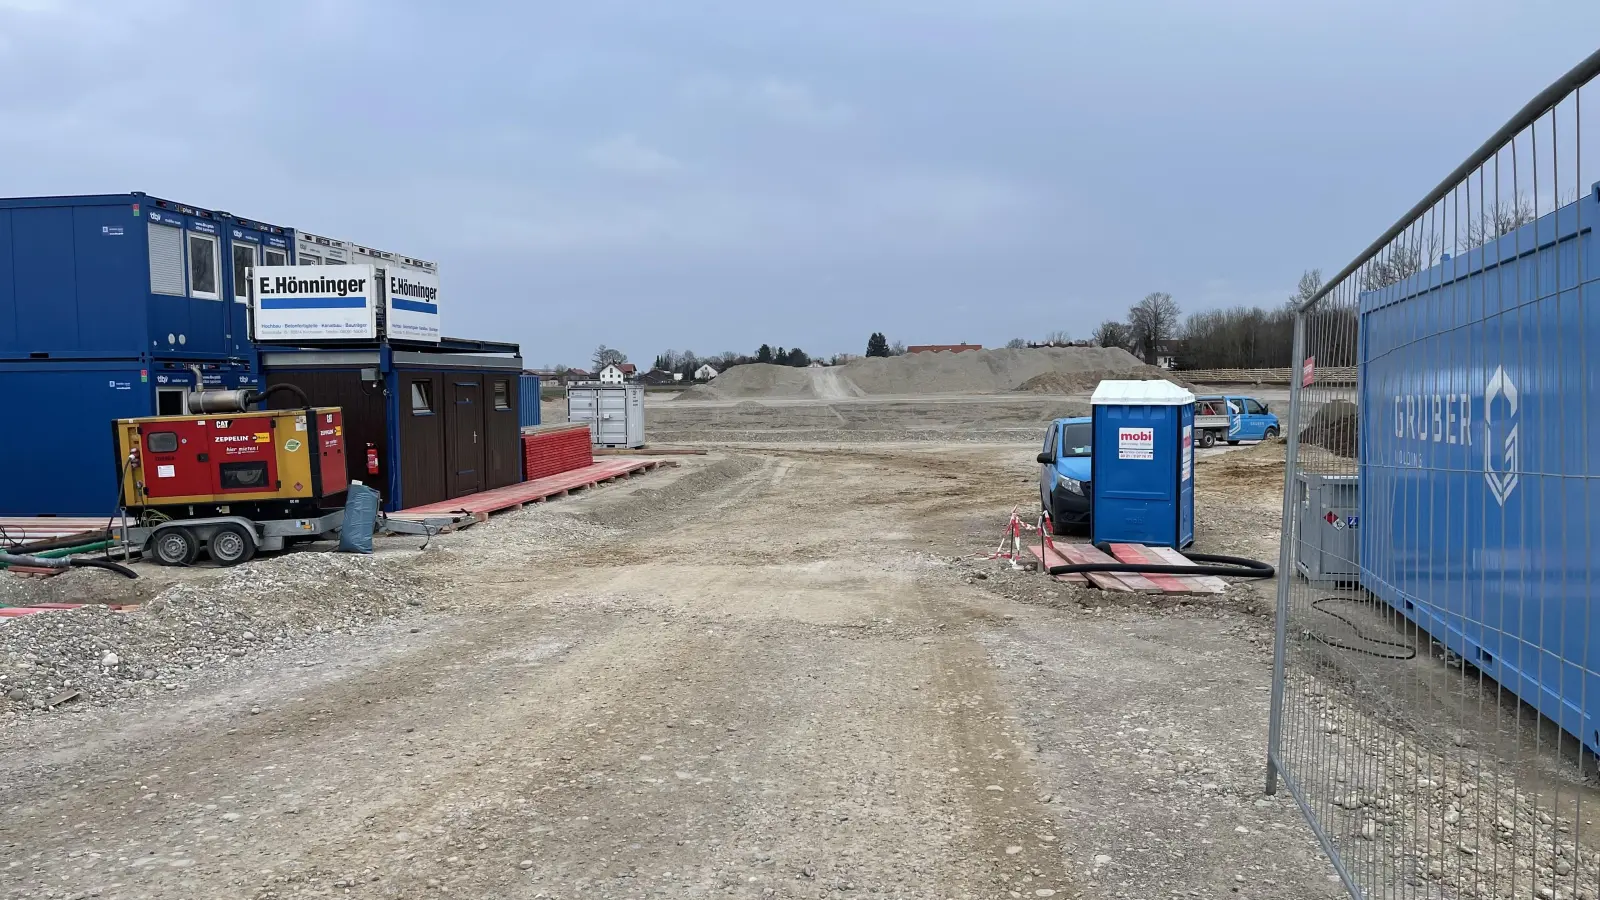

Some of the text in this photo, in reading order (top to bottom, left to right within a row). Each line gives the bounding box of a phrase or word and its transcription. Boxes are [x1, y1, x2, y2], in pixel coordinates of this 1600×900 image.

[260, 276, 366, 296] E.Hönninger
[391, 276, 437, 302] E.Hönninger
[216, 420, 228, 428] CAT
[1395, 394, 1472, 446] GRUBER
[215, 435, 249, 443] ZEPPELIN
[1120, 431, 1152, 441] mobi
